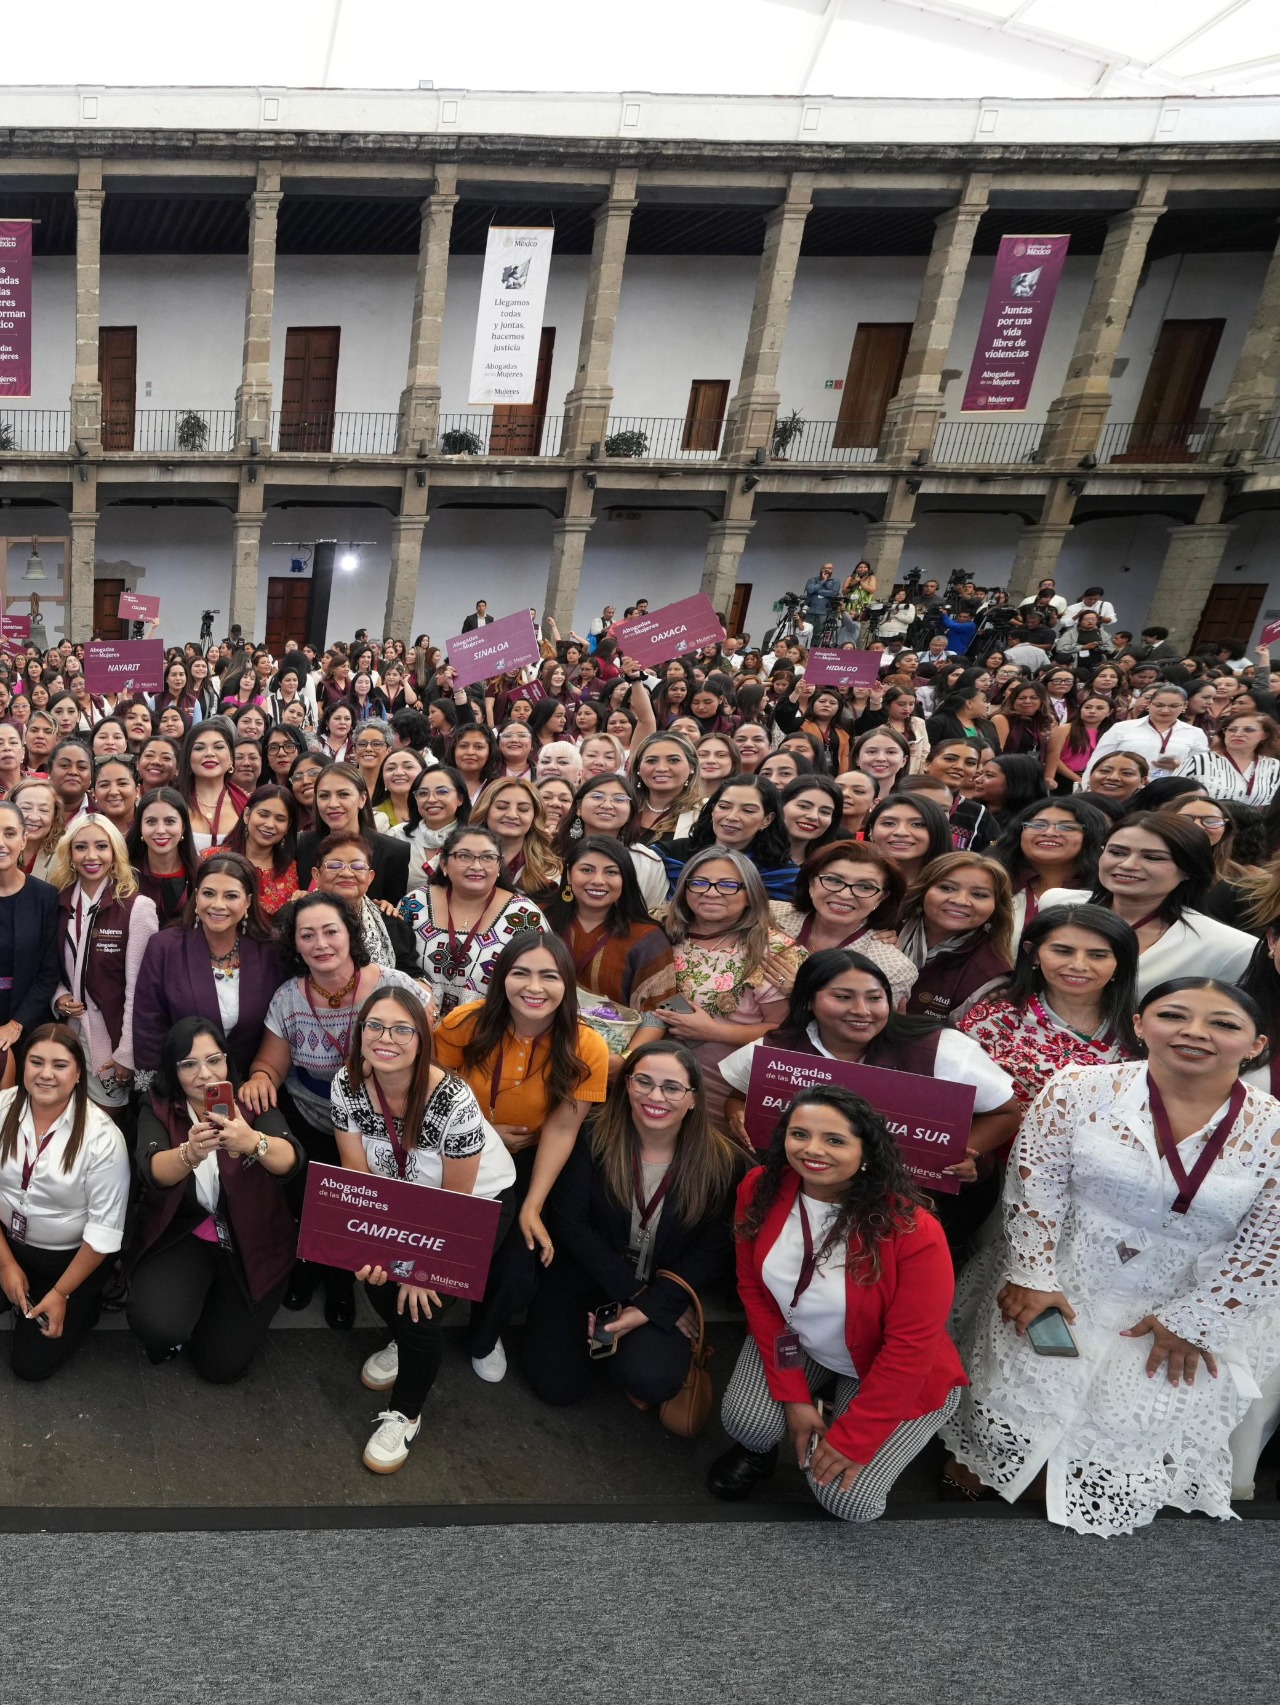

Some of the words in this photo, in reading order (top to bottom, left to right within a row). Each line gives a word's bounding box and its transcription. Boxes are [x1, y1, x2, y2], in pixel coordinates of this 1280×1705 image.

[494, 299, 530, 307] Llegamos
[1002, 306, 1033, 314] Juntas
[997, 318, 1015, 327] por
[1003, 328, 1022, 336] vida
[992, 339, 1013, 347] libre
[985, 349, 1029, 358] violencias
[622, 620, 651, 635] Abogadas
[635, 622, 659, 636] Mujeres
[651, 625, 687, 643] OAXACA
[453, 635, 478, 649] Abogadas
[463, 638, 484, 650] Mujeres
[696, 633, 716, 644] Mujeres
[474, 641, 509, 660] SINALOA
[108, 663, 140, 672] NAYARIT
[767, 1060, 832, 1080] Abogadas
[762, 1096, 791, 1112] BAJ
[913, 1128, 950, 1145] SUR
[320, 1178, 378, 1198] Abogadas
[340, 1193, 388, 1211] Mujeres
[347, 1219, 446, 1252] CAMPECHE
[430, 1273, 469, 1288] Mujeres
